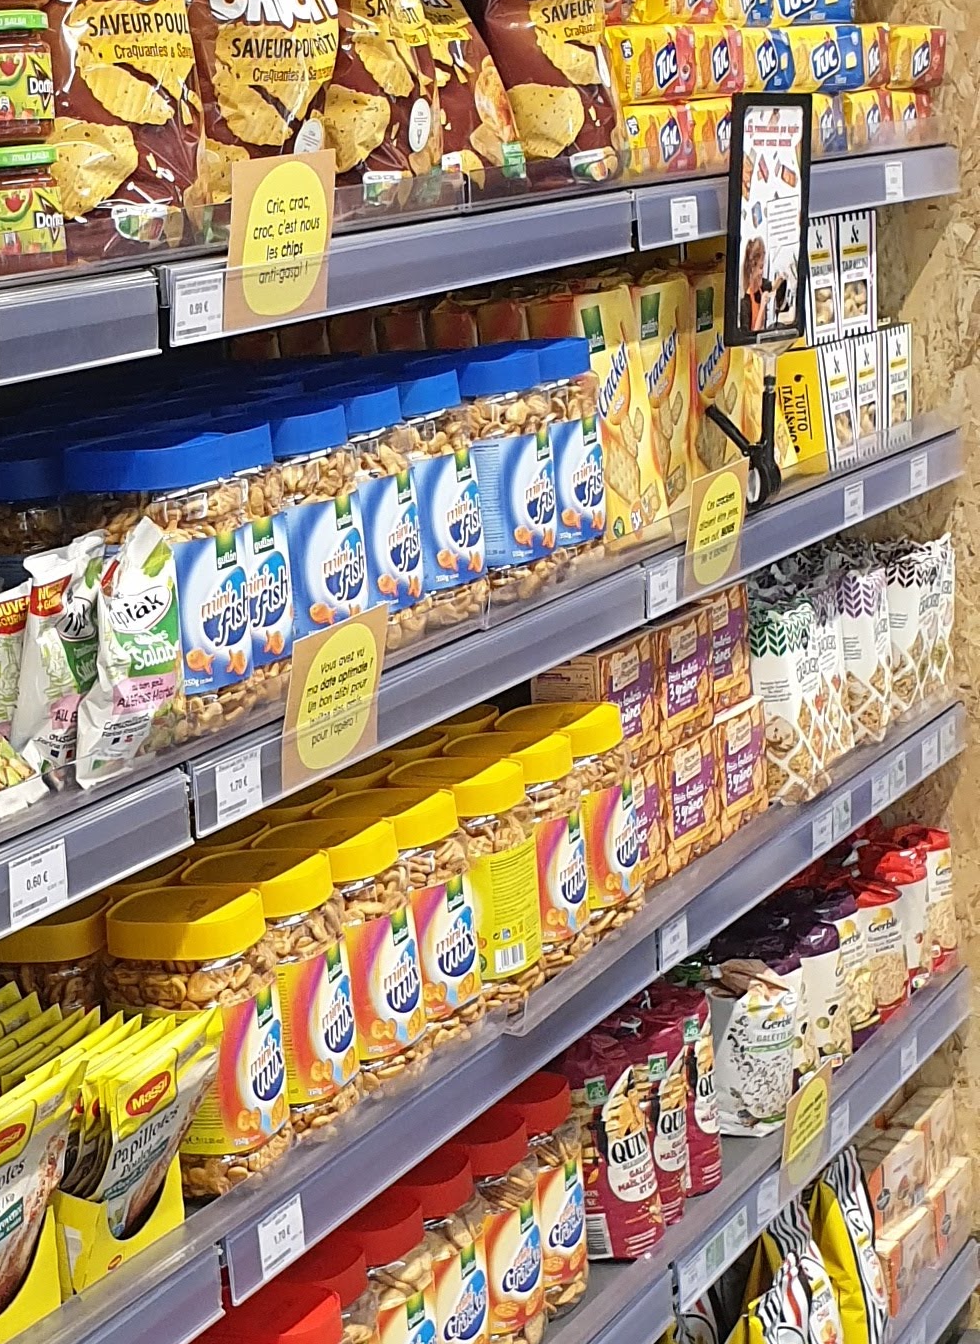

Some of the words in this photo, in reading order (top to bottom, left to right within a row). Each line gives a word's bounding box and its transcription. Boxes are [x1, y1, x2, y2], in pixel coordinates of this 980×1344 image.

[86, 13, 152, 37] SAVEUR
[656, 56, 678, 86] TUC
[266, 199, 285, 216] Cric,
[289, 194, 311, 211] crac,
[253, 226, 275, 242] croc,
[278, 219, 297, 236] c'est
[300, 216, 320, 231] nous
[266, 245, 278, 261] les
[281, 240, 303, 258] chips
[259, 263, 302, 284] anti-gaspi
[201, 581, 232, 618] mini
[252, 565, 289, 628] fish
[215, 584, 249, 647] fish
[436, 921, 465, 954] mini
[440, 932, 474, 973] mix
[131, 1076, 170, 1111] Maggi
[111, 1103, 179, 1170] Papillotes
